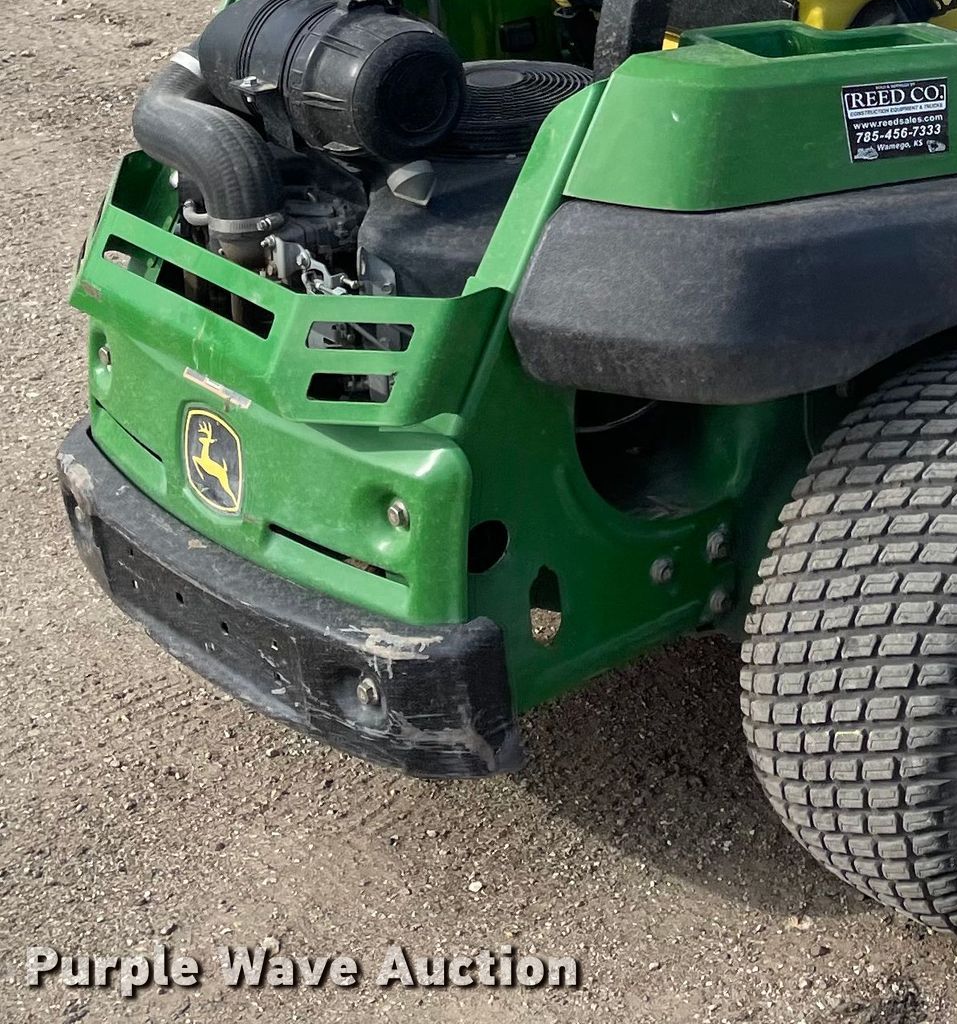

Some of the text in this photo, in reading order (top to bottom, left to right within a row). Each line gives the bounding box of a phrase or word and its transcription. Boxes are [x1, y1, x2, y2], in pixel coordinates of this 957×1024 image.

[850, 85, 944, 108] REED CO.
[850, 108, 890, 117] CONSTRUCTION
[890, 105, 919, 113] EQUIPMENT
[853, 114, 943, 130] www.reedsales.com
[856, 124, 941, 144] 785-456-7333
[877, 139, 923, 152] Wamego, KS
